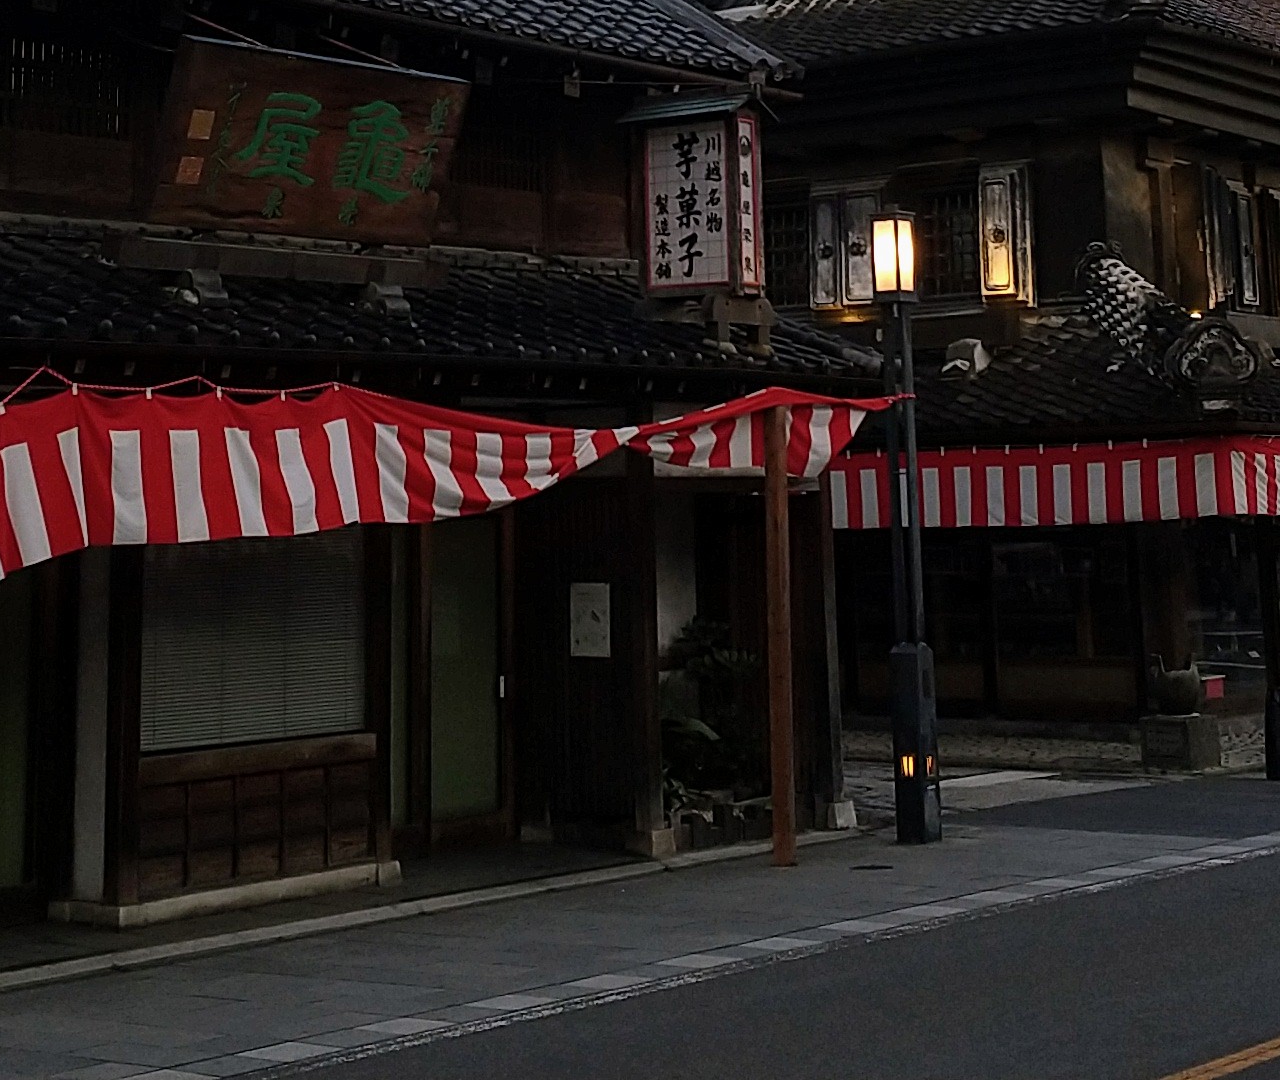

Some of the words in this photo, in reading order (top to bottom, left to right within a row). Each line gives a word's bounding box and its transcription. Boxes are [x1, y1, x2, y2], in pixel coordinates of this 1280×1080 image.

[673, 131, 703, 278] 芋菓子
[705, 133, 723, 233] 川越名物
